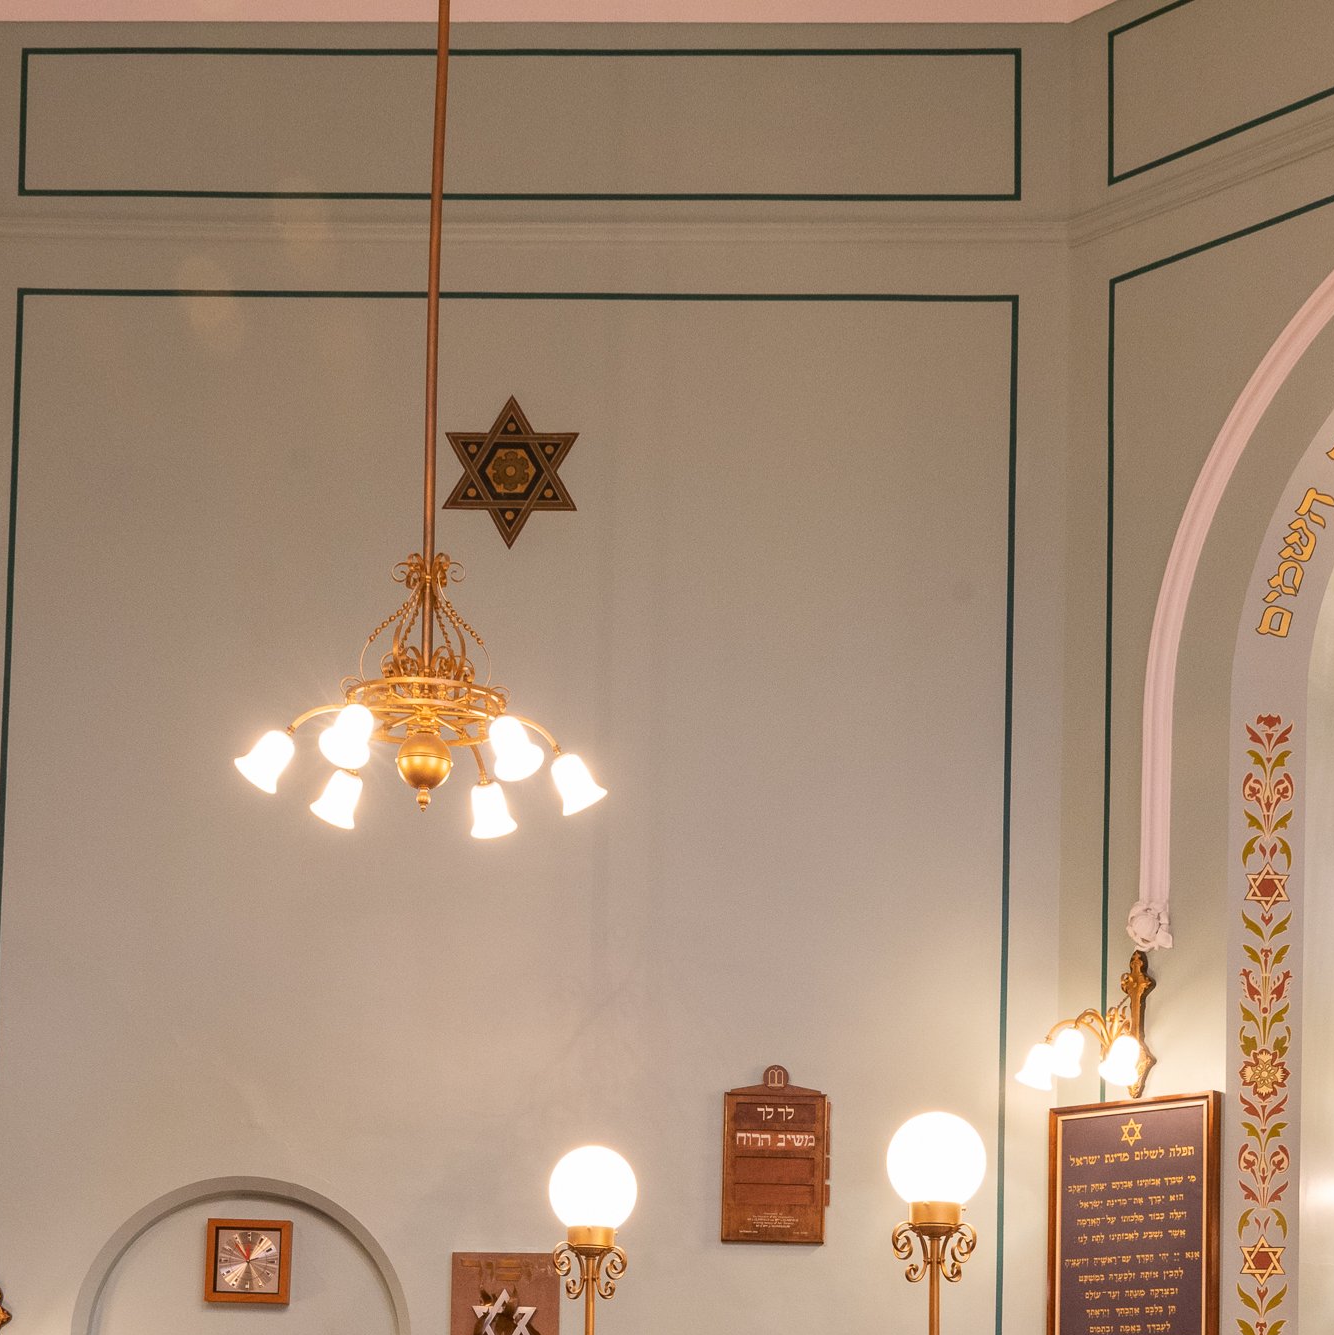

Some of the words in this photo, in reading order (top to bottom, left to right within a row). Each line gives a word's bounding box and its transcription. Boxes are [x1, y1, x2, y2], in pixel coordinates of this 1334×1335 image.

[757, 1105, 774, 1121] לך
[778, 1105, 794, 1121] לך
[736, 1132, 770, 1147] הרוח
[777, 1132, 815, 1147] משיב
[1134, 1147, 1164, 1159] לשלום
[1169, 1144, 1194, 1156] תפלה
[1069, 1154, 1100, 1166] ישראל
